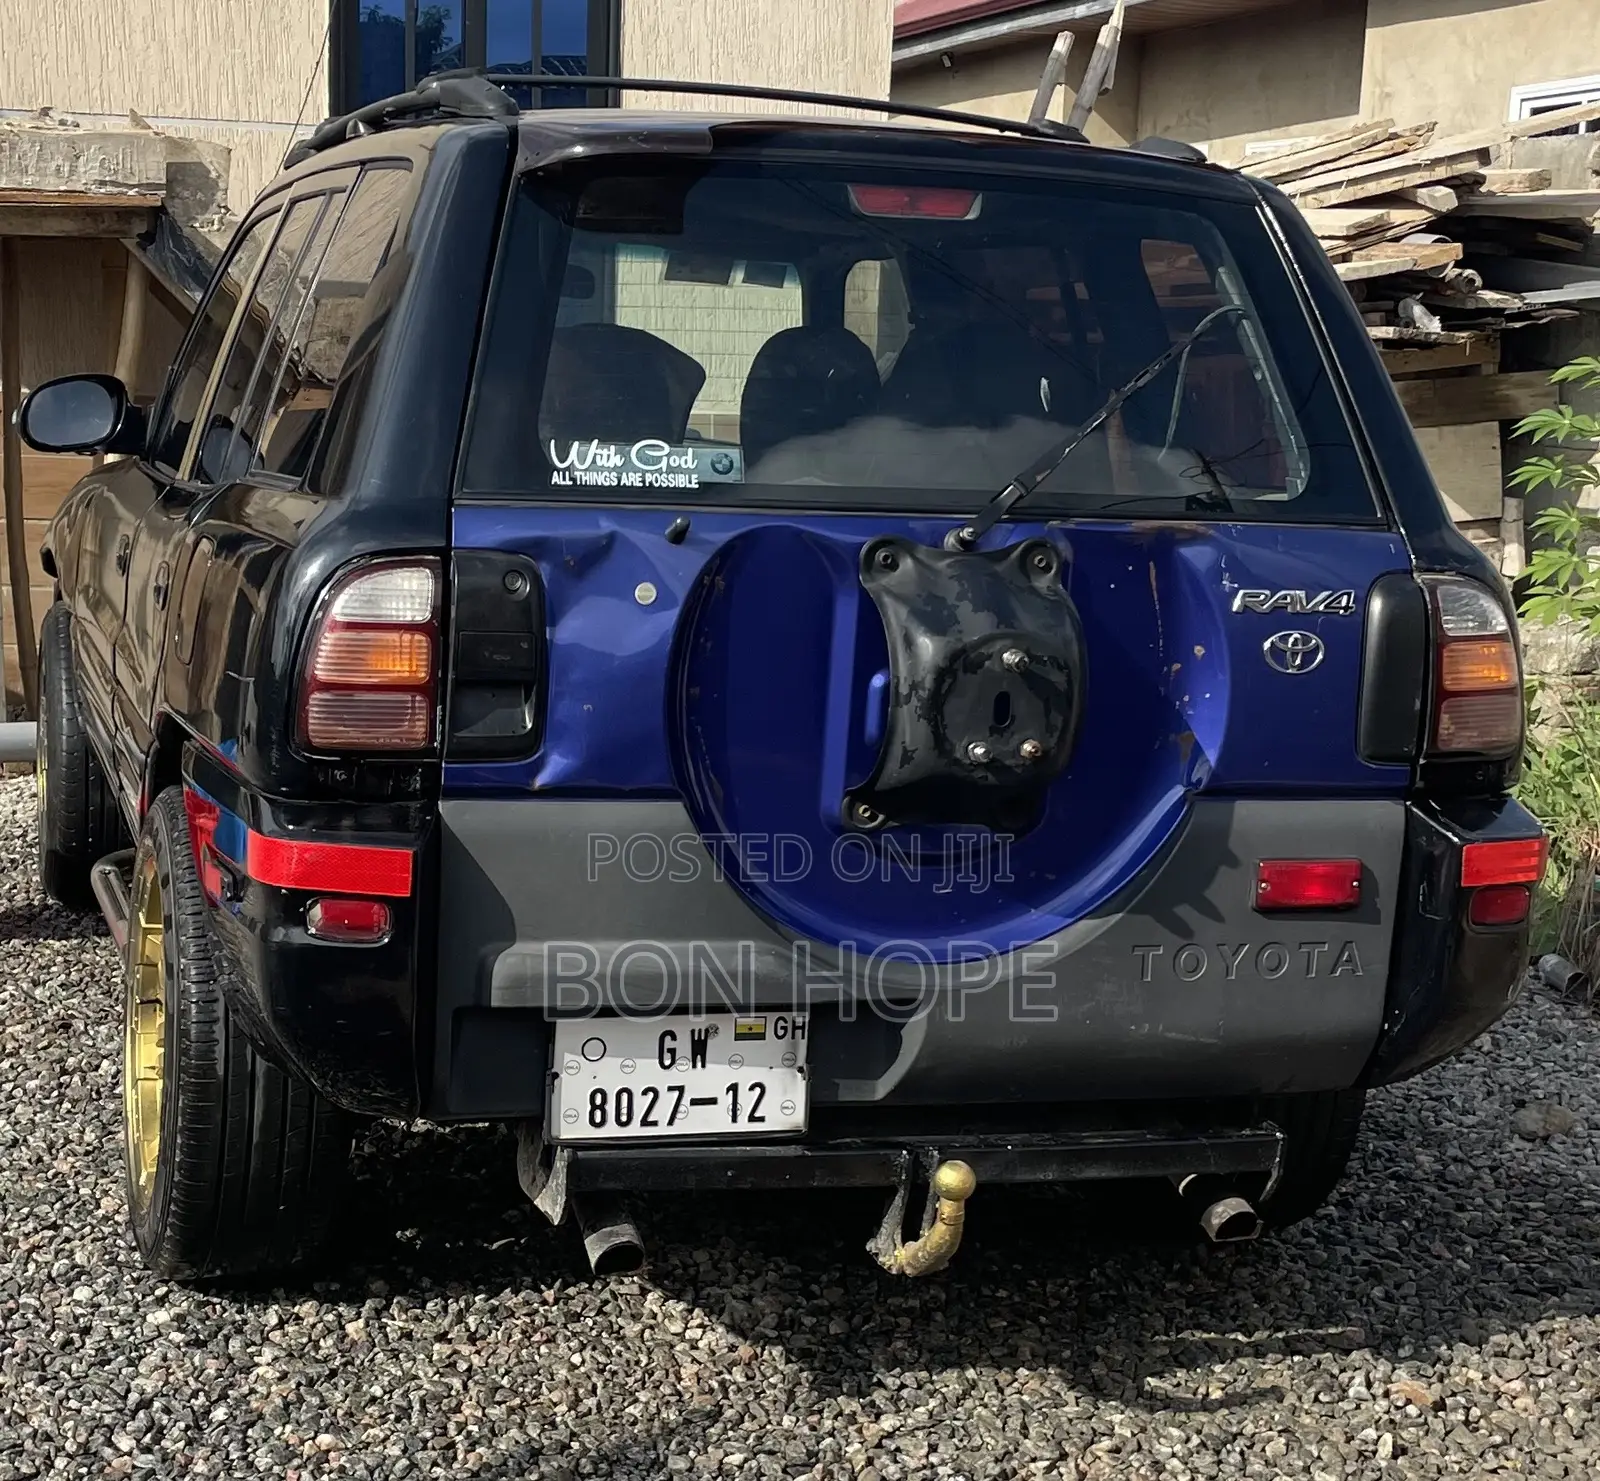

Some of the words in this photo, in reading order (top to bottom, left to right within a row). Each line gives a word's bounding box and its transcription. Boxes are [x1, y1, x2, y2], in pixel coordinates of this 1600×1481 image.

[550, 438, 625, 469] With
[630, 438, 699, 472] God
[551, 470, 573, 485] ALL
[574, 471, 618, 486] THINGS
[621, 471, 643, 487] ARE
[645, 473, 699, 489] POSSIBLE
[1232, 589, 1356, 615] RAV4
[1132, 940, 1364, 983] TOYOTA
[773, 1015, 806, 1041] GH
[587, 1081, 767, 1128] 8027-12
